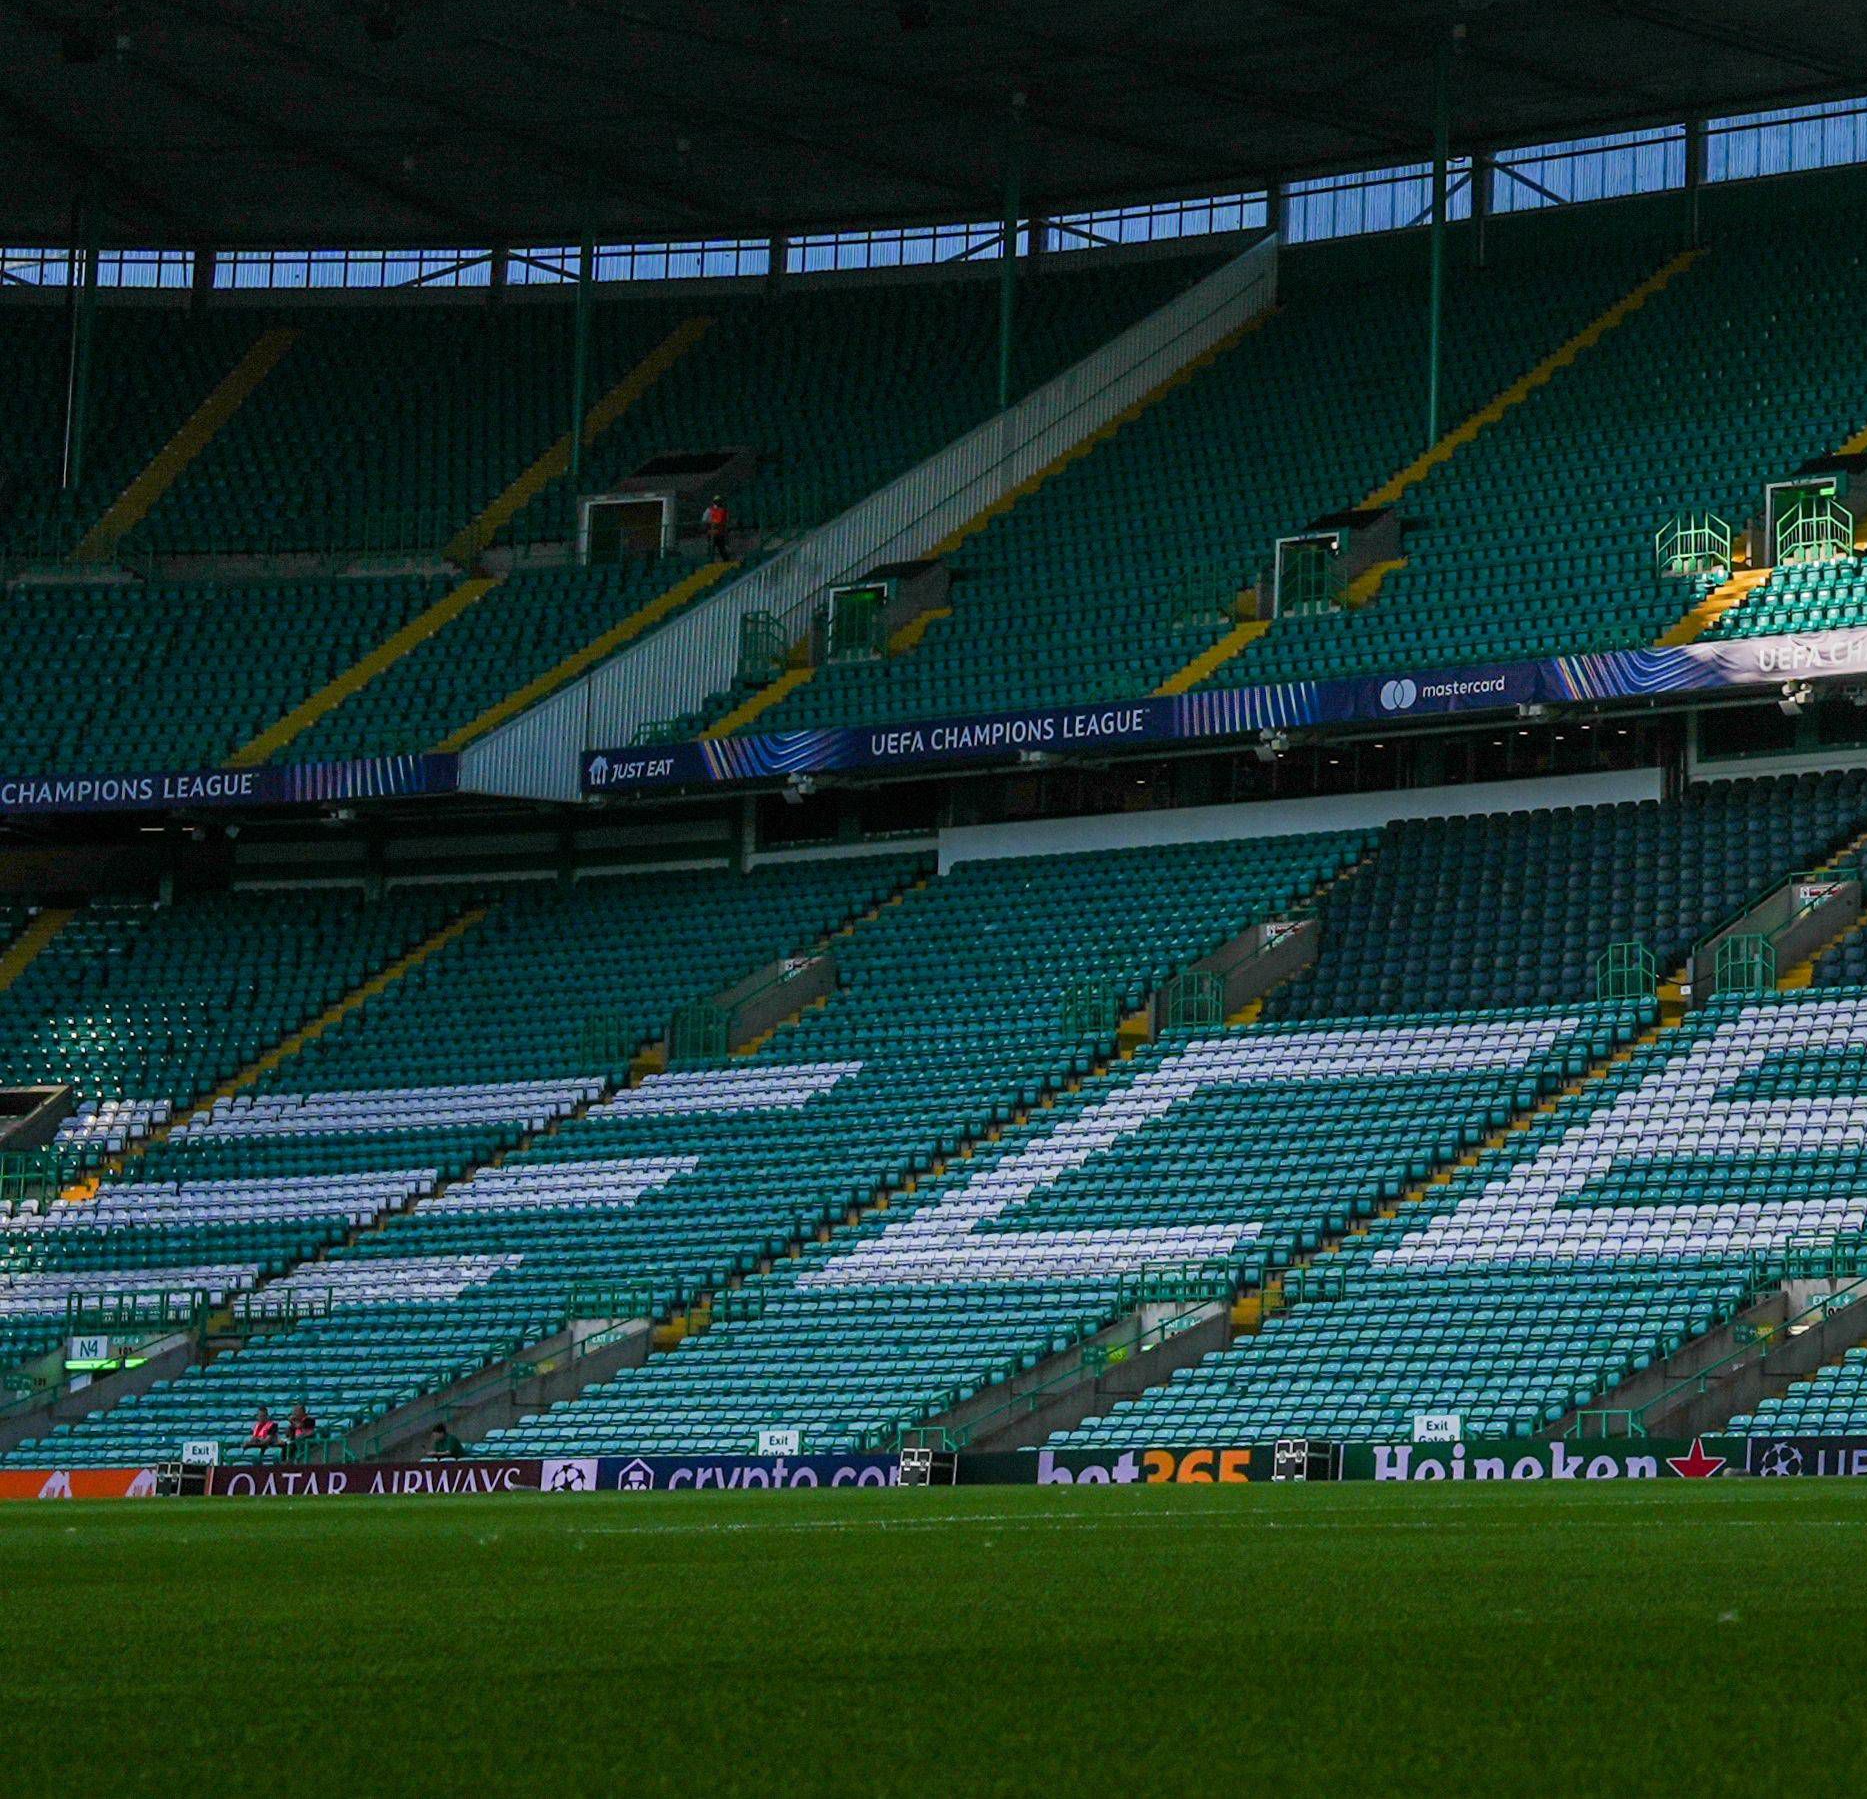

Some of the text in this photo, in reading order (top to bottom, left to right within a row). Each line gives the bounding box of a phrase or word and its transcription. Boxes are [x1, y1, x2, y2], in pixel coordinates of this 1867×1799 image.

[1757, 645, 1819, 670] UEFA
[1422, 675, 1505, 700] mastercard
[871, 708, 1145, 755] UEFA CHAMPIONS LEAGUE
[611, 758, 673, 780] JUST EAT
[1, 773, 254, 804] CHAMPIONS LEAGUE
[1426, 1420, 1447, 1431] Exit
[192, 1445, 209, 1455] Exit
[769, 1435, 788, 1445] Exit
[1038, 1448, 1252, 1484] bet365
[1374, 1442, 1657, 1480] Heineken
[369, 1466, 521, 1495] AIRWAYS
